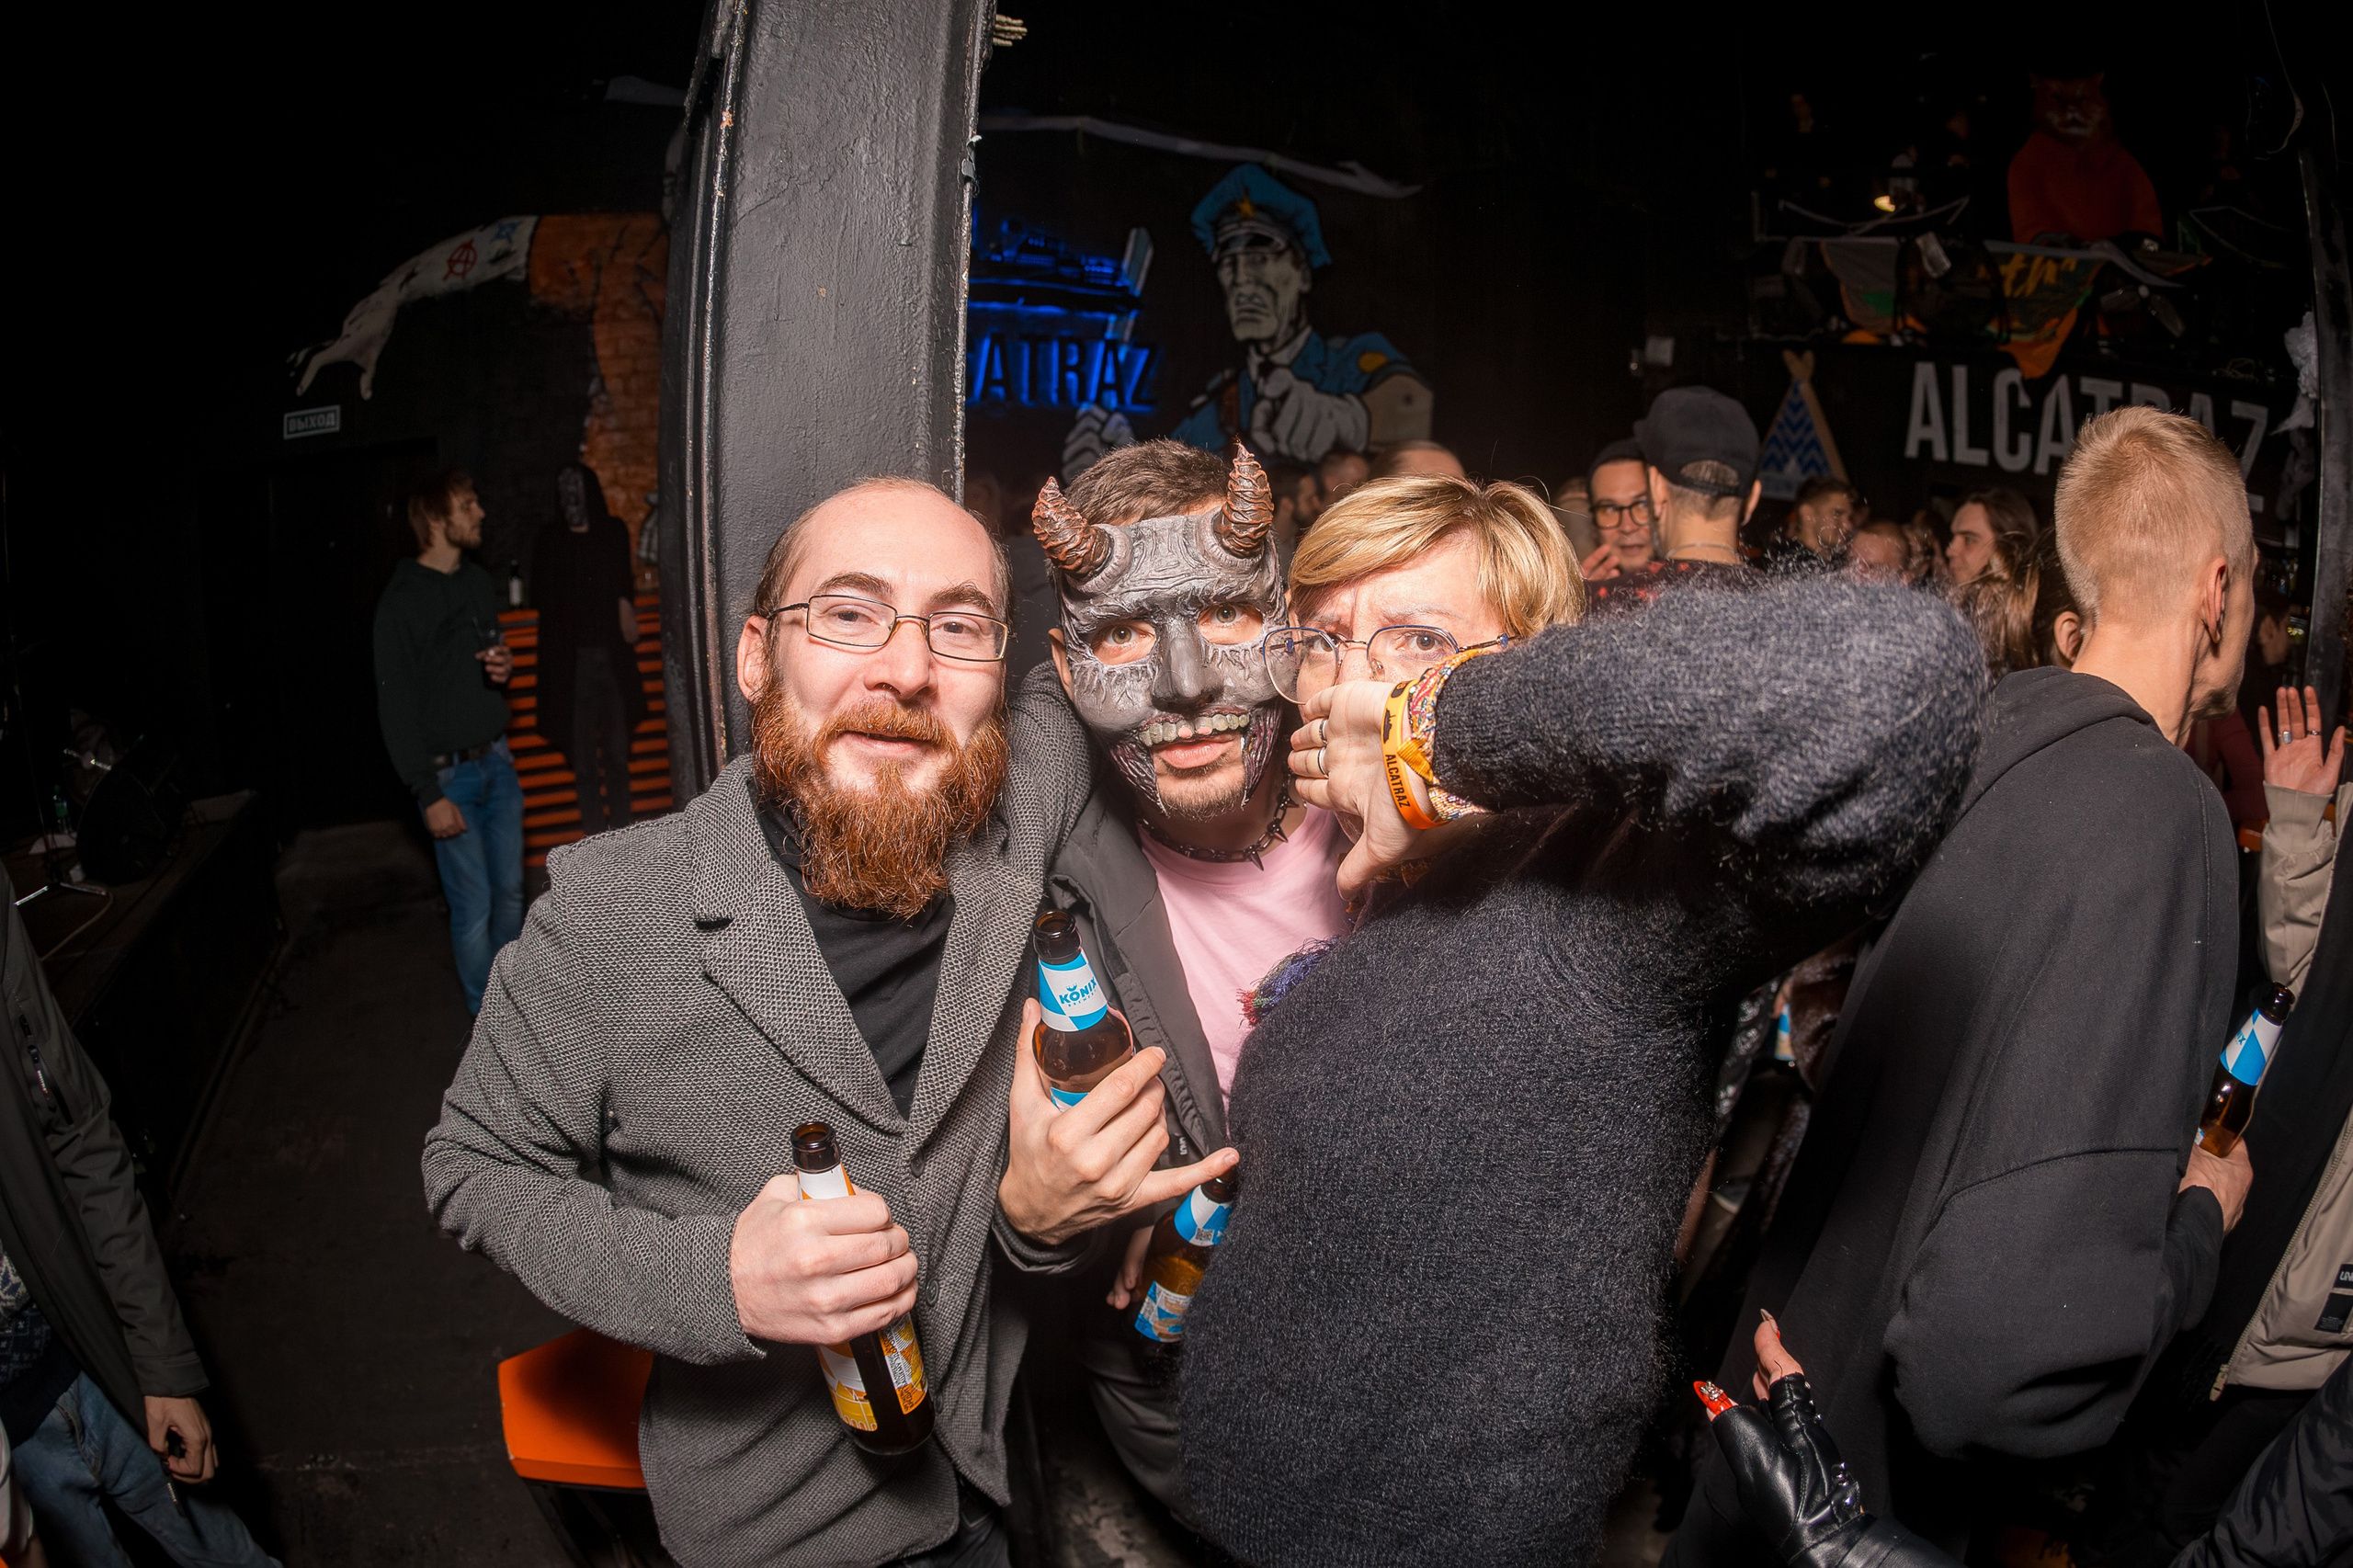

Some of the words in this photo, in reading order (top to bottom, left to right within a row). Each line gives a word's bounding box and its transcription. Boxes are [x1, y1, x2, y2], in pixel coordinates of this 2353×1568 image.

[966, 334, 1157, 407] ATRAZ
[289, 412, 335, 433] ВЫХОД
[1904, 360, 2269, 513] ALCAZ
[1385, 754, 1411, 808] ALCATRAZ
